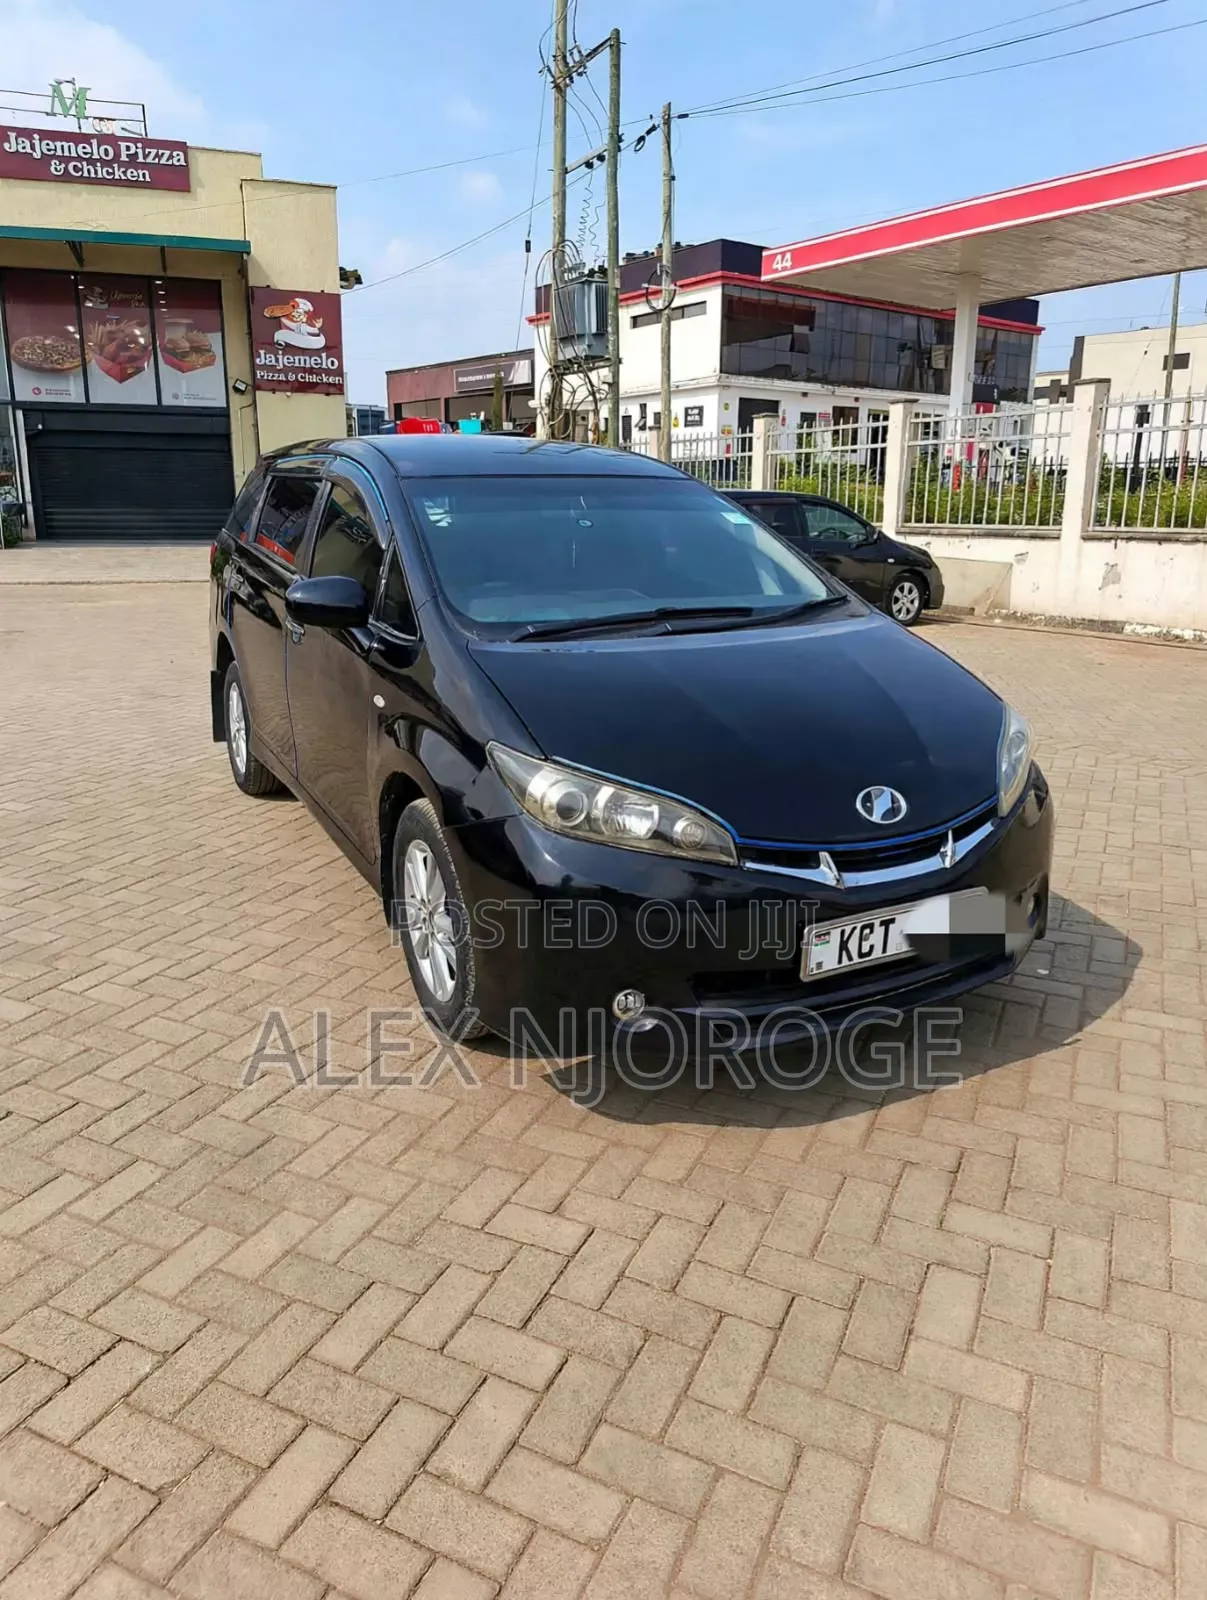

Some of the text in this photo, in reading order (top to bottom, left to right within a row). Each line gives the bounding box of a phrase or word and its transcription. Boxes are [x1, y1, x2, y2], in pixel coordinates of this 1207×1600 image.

[3, 131, 187, 166] Jajemelo Pizza
[50, 159, 151, 182] & Chicken
[772, 251, 792, 271] 44
[256, 349, 339, 370] Jajemelo
[256, 370, 343, 384] Pizza & Chicken
[837, 917, 896, 965] KCT
